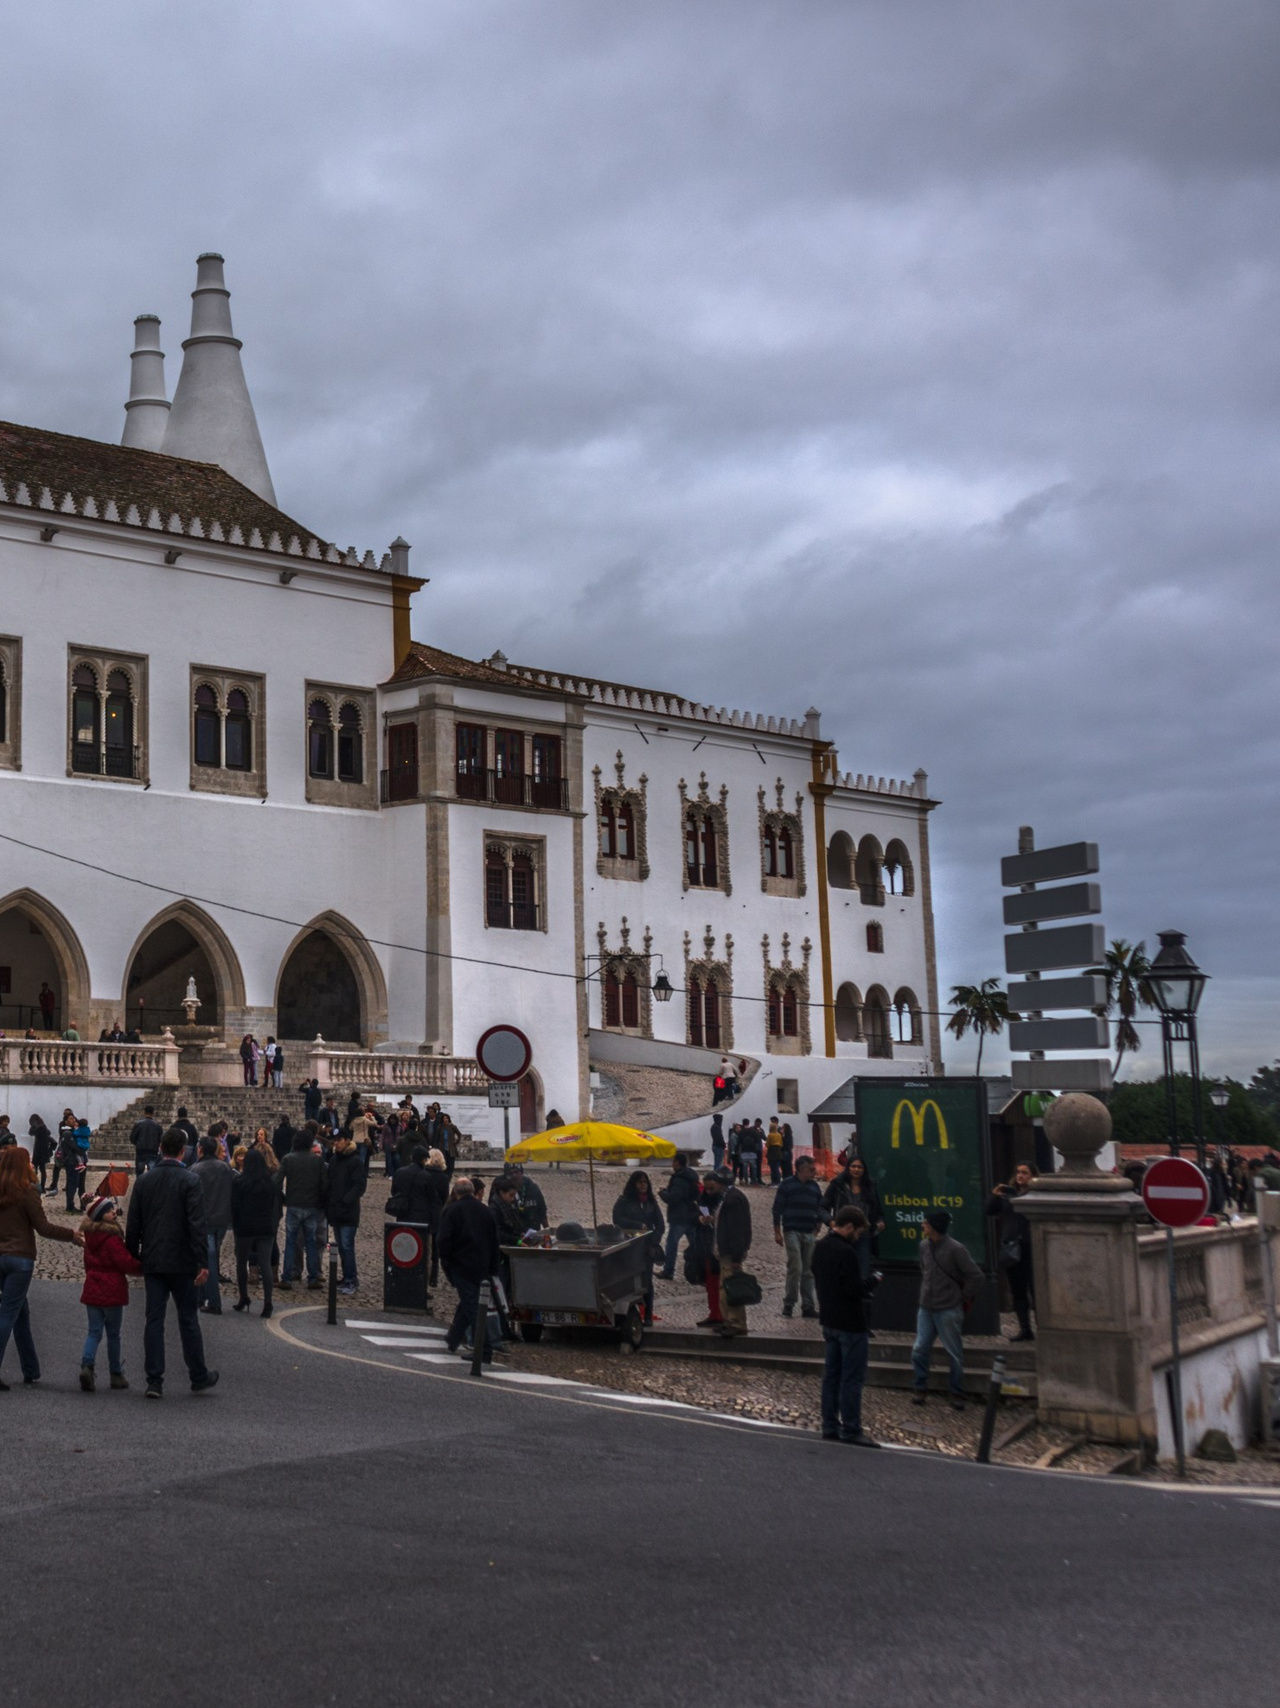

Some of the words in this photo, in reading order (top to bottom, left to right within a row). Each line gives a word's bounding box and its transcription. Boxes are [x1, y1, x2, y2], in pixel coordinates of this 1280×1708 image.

[884, 1194, 929, 1207] Lisboa
[933, 1195, 964, 1208] IC19
[900, 1227, 917, 1239] 10
